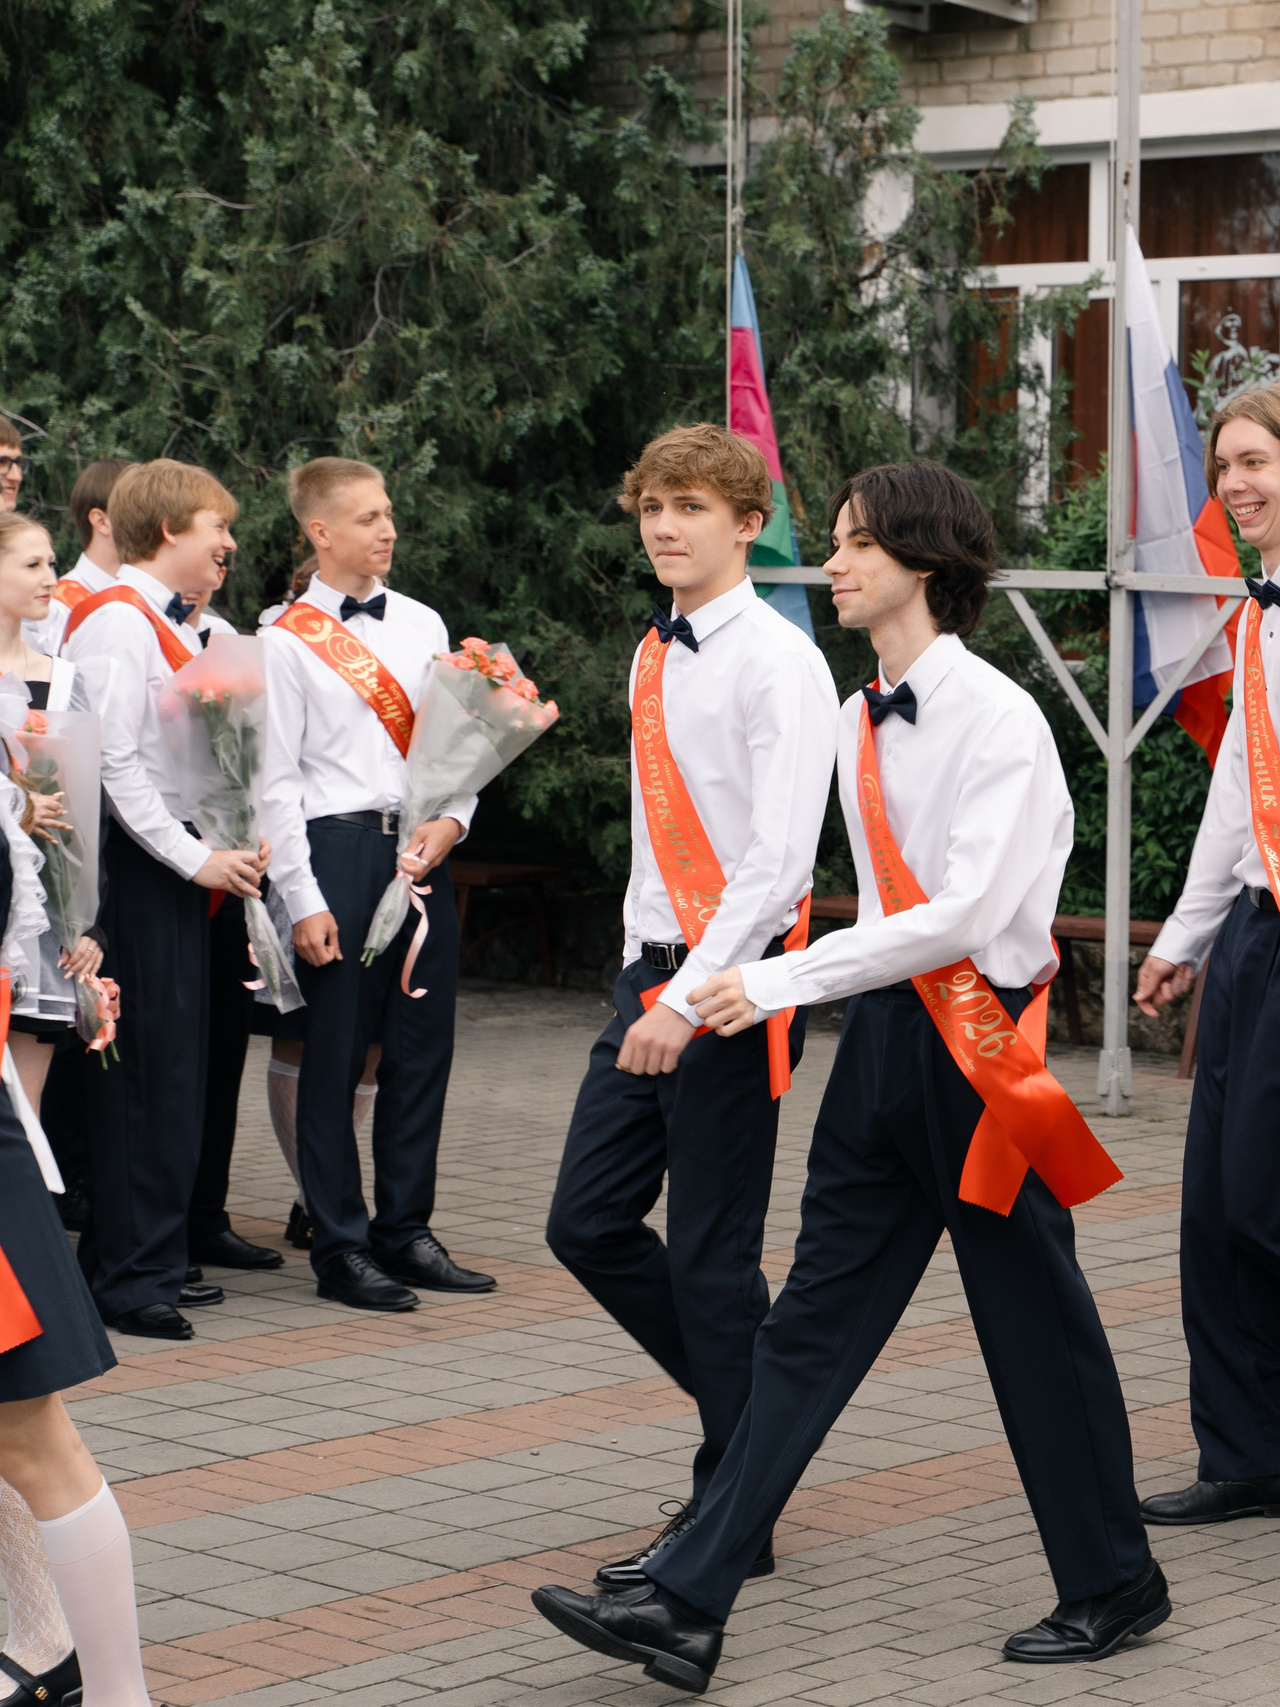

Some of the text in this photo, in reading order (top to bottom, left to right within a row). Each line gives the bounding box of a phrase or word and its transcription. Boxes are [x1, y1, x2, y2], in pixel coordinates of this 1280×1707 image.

[641, 694, 697, 877] Выпускник
[1246, 645, 1278, 810] Выпускник
[691, 883, 725, 923] 20
[934, 971, 1017, 1057] 2026
